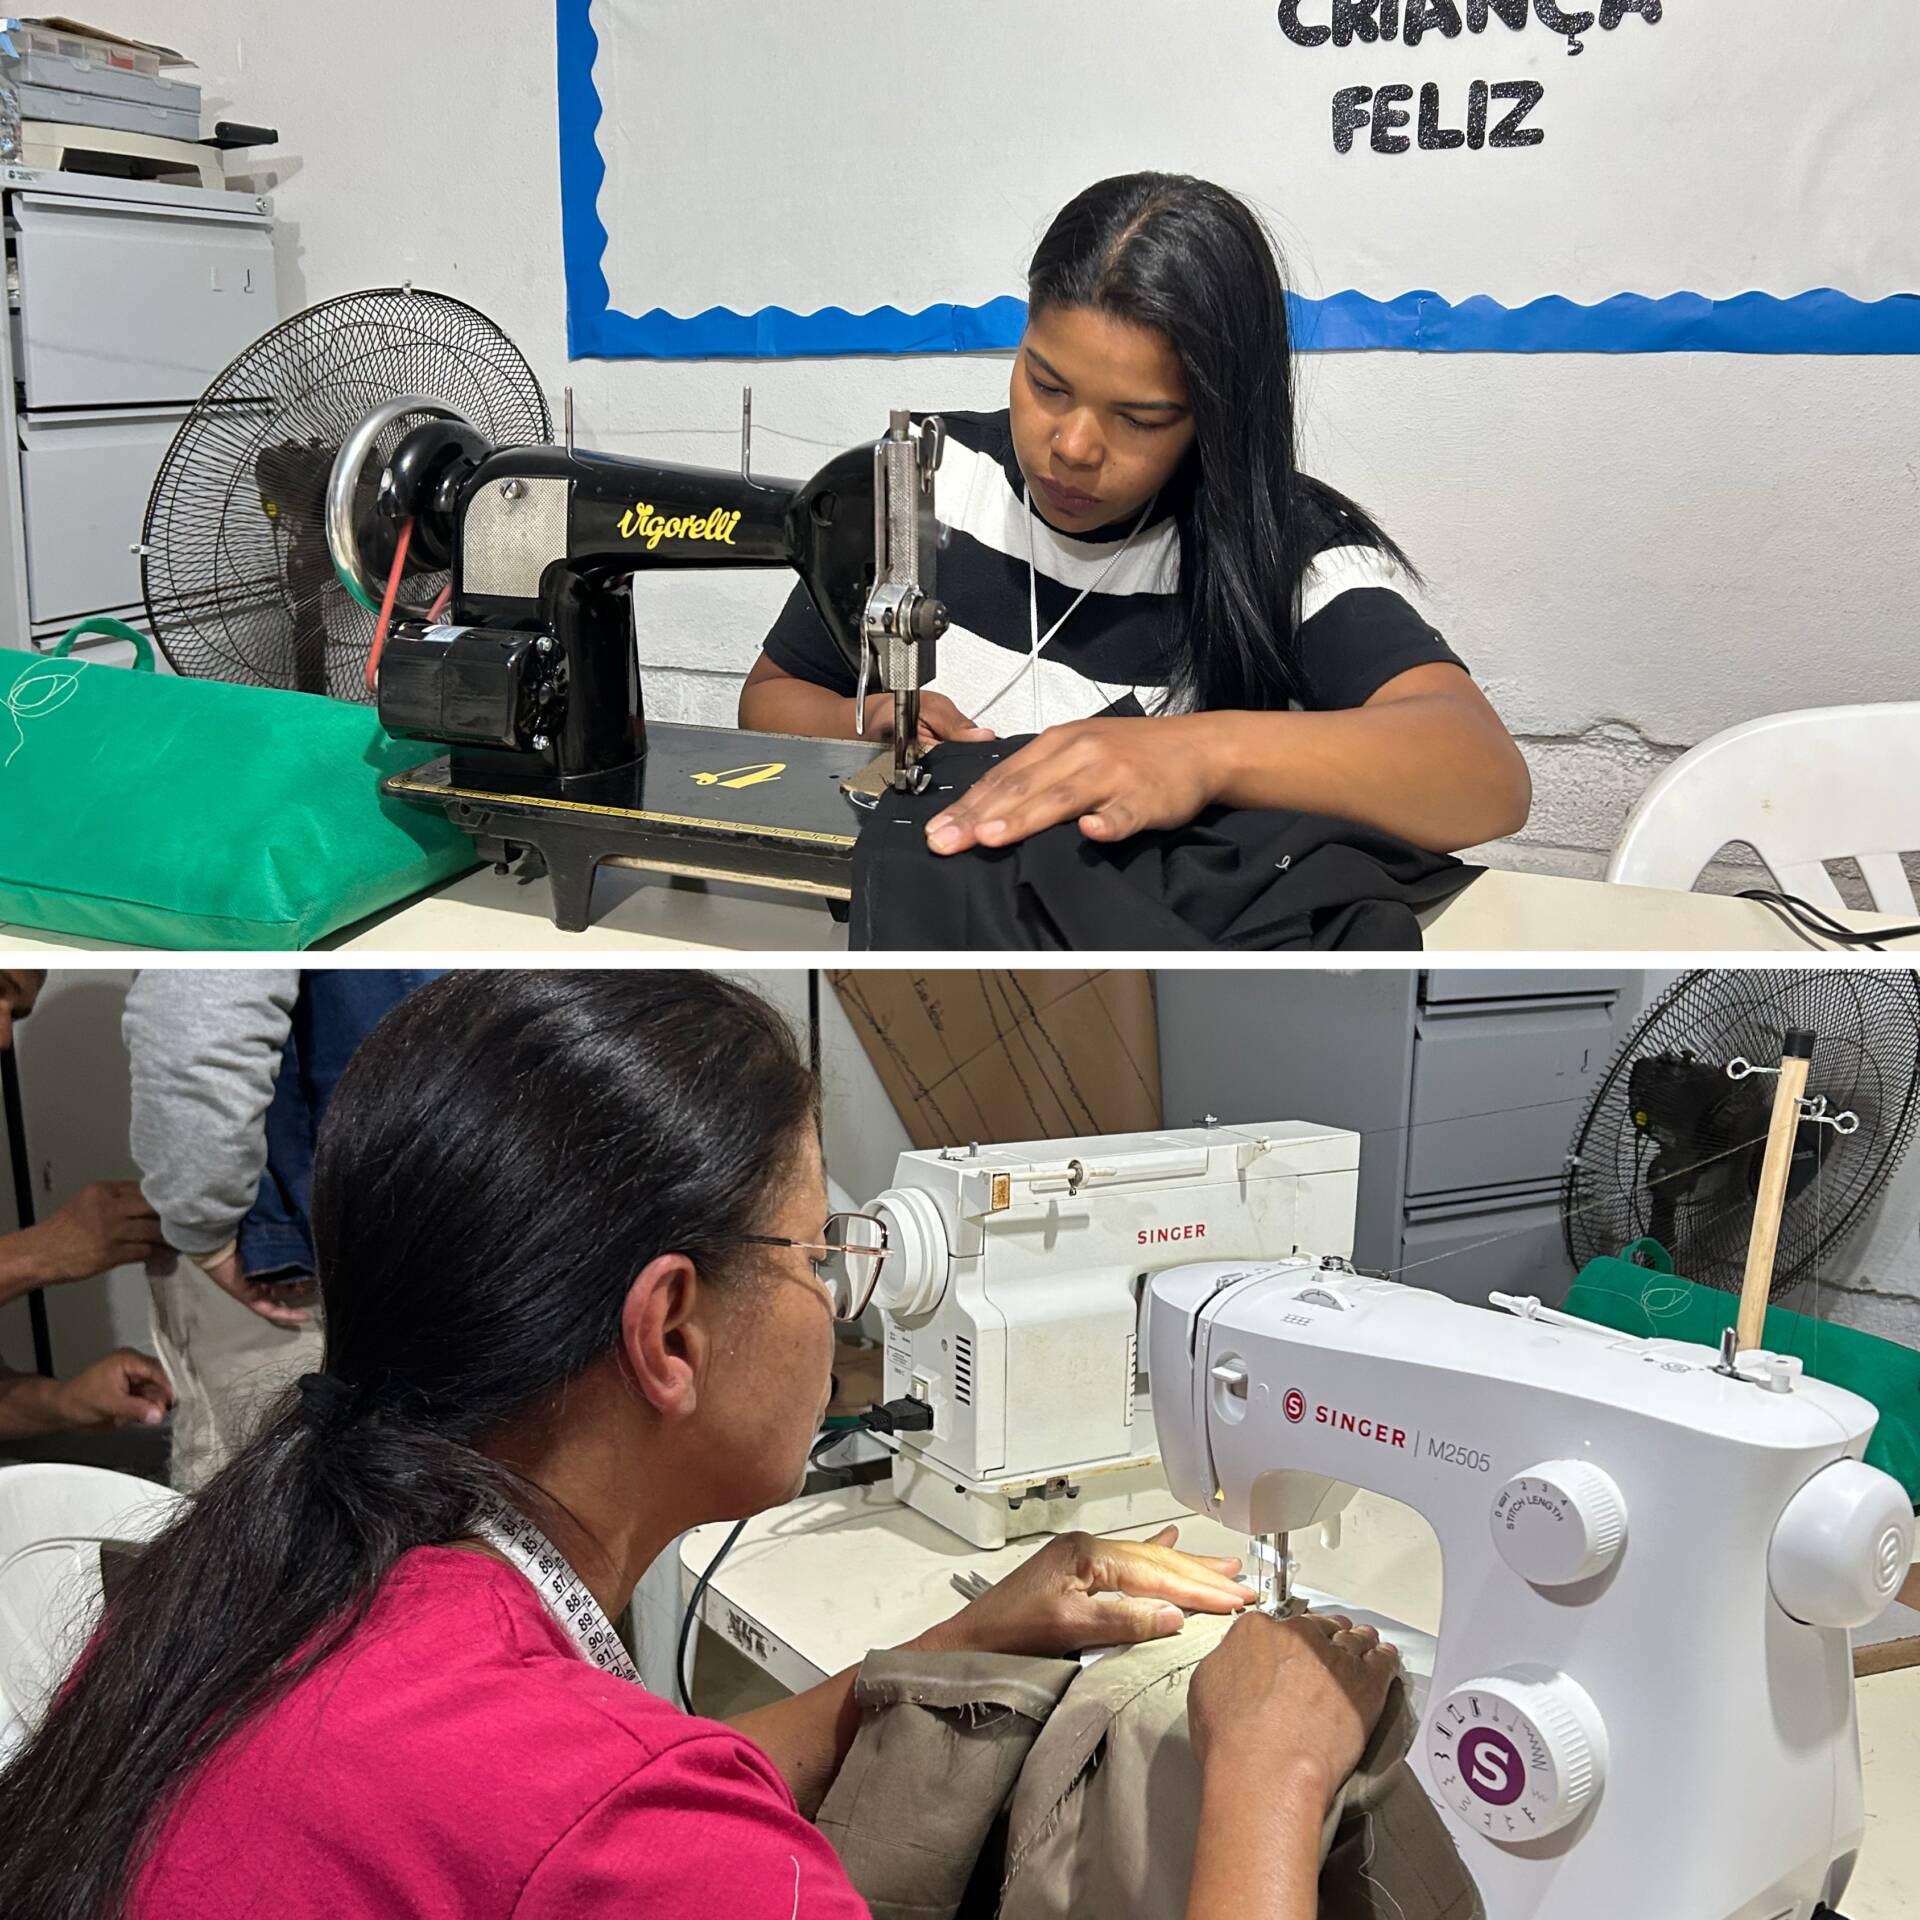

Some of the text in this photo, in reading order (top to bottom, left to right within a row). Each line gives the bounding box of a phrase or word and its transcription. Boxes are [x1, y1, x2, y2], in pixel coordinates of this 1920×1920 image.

[1332, 80, 1544, 153] FELIZ
[617, 502, 741, 549] Vigorelli
[1137, 1224, 1206, 1245] SINGER
[1315, 1405, 1406, 1448] SINGER
[1427, 1437, 1491, 1472] M2505
[1520, 1480, 1527, 1490] 2
[1505, 1495, 1564, 1531] STITCH LENGTH
[502, 1519, 519, 1536] 84
[521, 1535, 538, 1555] 85
[538, 1555, 553, 1574] 86
[552, 1573, 566, 1594] 87
[565, 1593, 580, 1613] 88
[578, 1612, 593, 1632] 89
[588, 1631, 603, 1649] 90
[596, 1648, 612, 1665] 91
[1471, 1741, 1510, 1791] S
